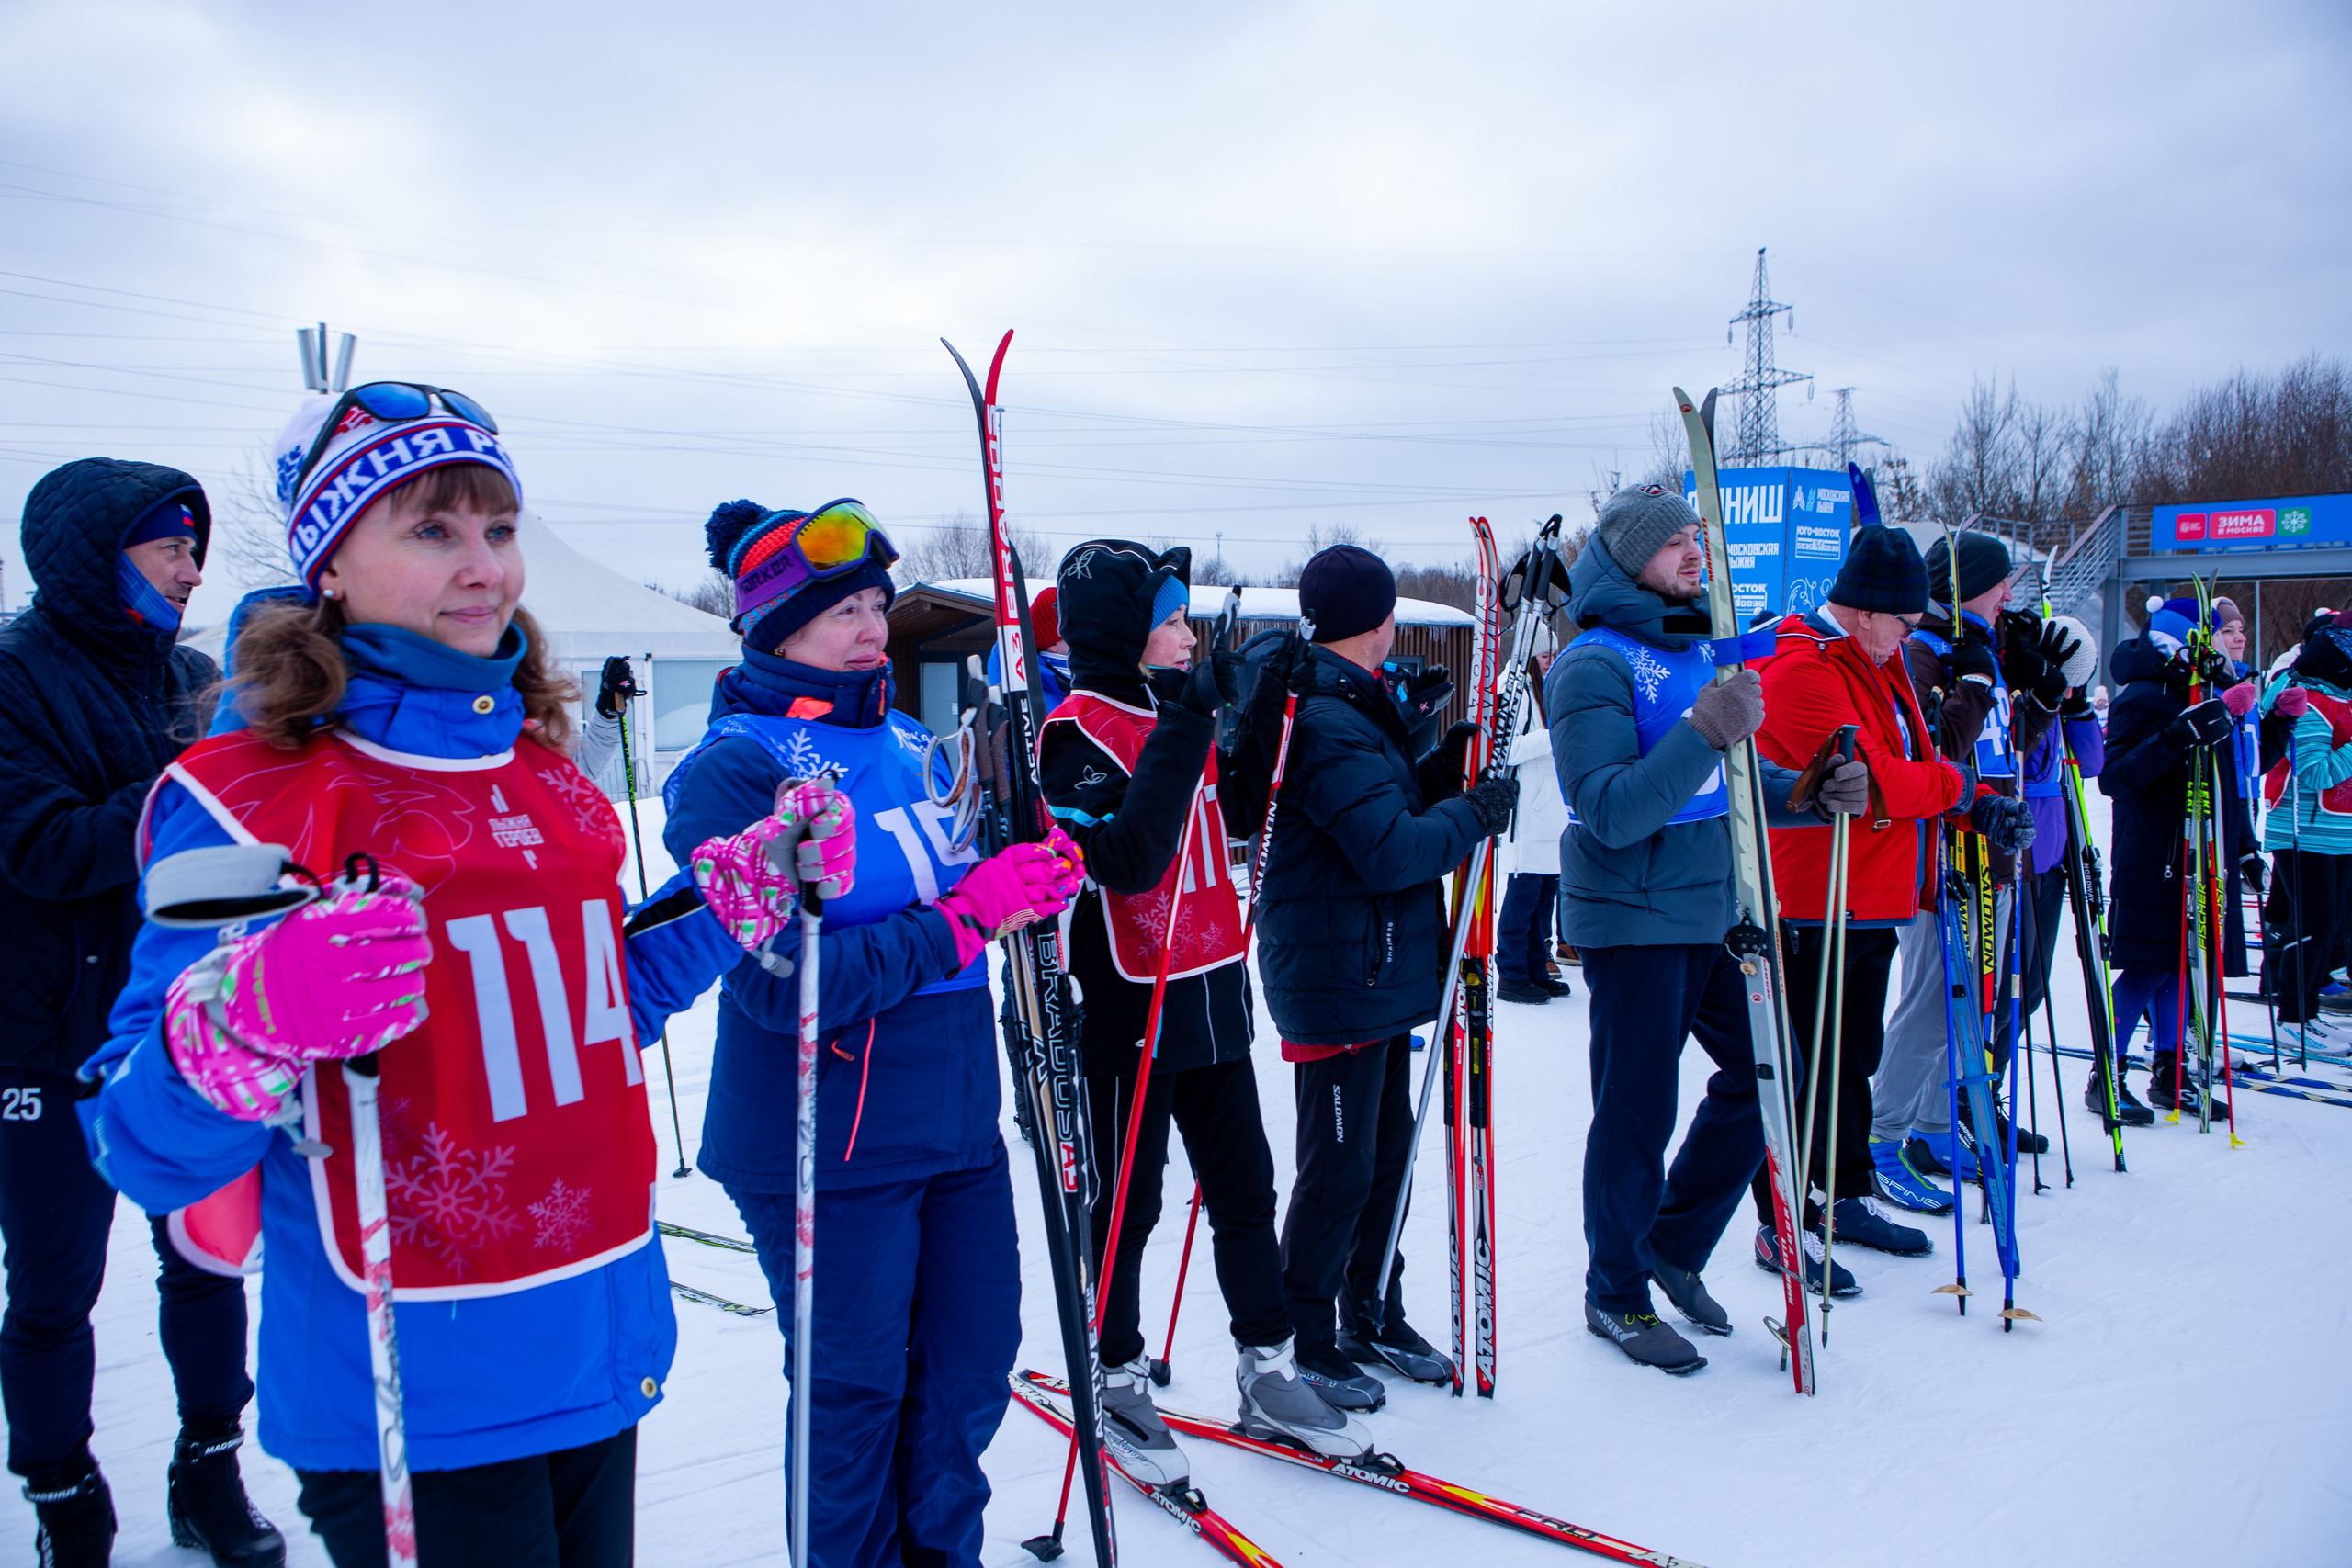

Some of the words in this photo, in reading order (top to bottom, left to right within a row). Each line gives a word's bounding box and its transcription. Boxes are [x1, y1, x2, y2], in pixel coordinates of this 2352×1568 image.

[987, 404, 1019, 601] BRADOS
[1688, 485, 1784, 525] НИШ
[2218, 514, 2265, 528] ЗИМА
[1797, 525, 1841, 538] ЮГО-ВОСТОК
[2226, 525, 2265, 535] МОСКВЕ
[1021, 697, 1040, 785] ACTIVE
[2201, 782, 2211, 815] LEKI
[492, 828, 545, 848] ГЕРОЕВ
[1251, 800, 1278, 906] SALOMON
[2083, 863, 2095, 903] NORDWAY
[1980, 865, 1995, 970] SALOMON
[2197, 880, 2207, 951] FISCHER
[445, 898, 644, 1123] 114
[1, 1087, 43, 1121] 25
[1332, 1084, 1344, 1143] SALOMON
[1876, 1171, 1943, 1210] SPINE
[1785, 1208, 1795, 1256] TOUR
[1780, 1237, 1795, 1306] MARETTI
[1450, 1235, 1464, 1383] ATOMIC
[1474, 1238, 1495, 1385] ATOMIC
[1088, 1332, 1103, 1438] ACTIVE
[1331, 1463, 1411, 1495] ATOMIC
[1149, 1489, 1203, 1533] ATOMIC
